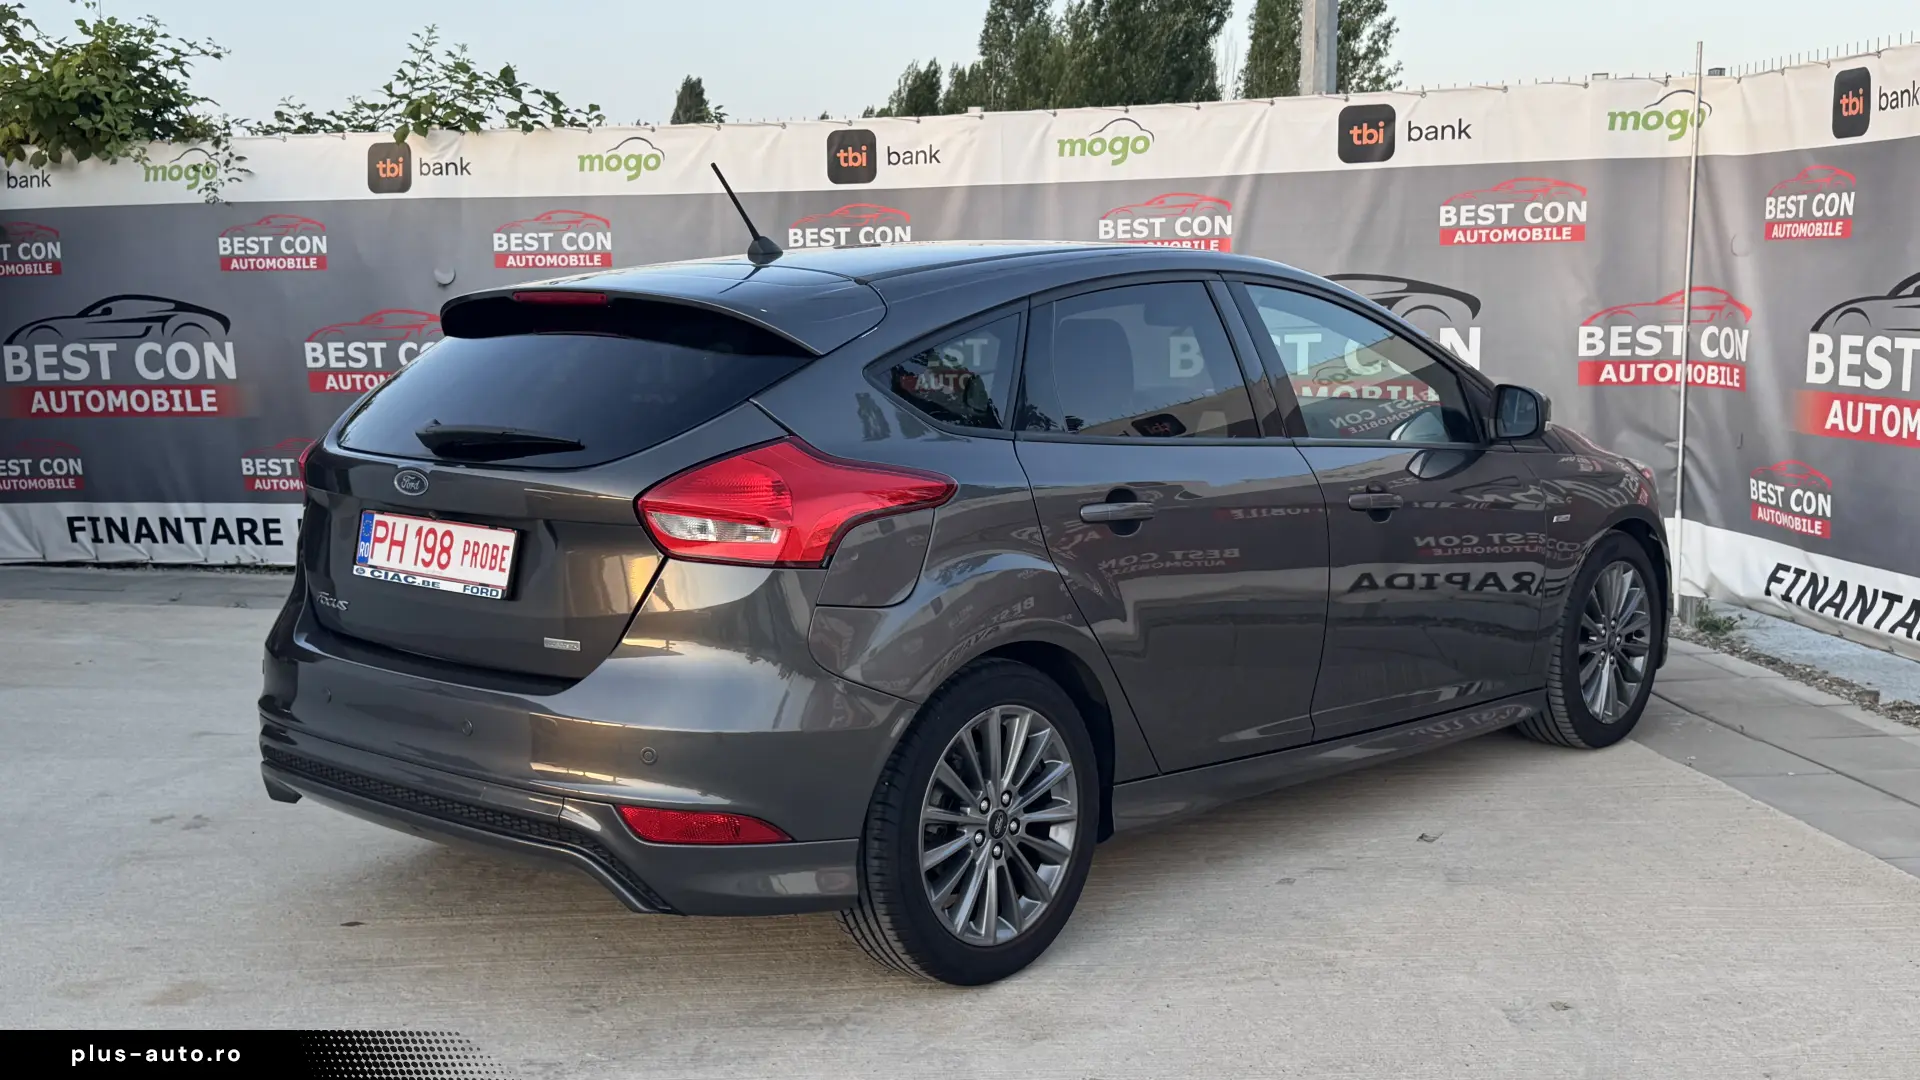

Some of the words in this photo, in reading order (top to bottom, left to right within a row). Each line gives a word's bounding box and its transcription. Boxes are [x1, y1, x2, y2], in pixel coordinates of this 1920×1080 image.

[1839, 87, 1864, 117] tbi
[1878, 80, 1920, 111] bank
[1349, 120, 1385, 146] tbi
[1407, 118, 1472, 142] bank
[1607, 107, 1706, 142] mogo
[836, 145, 867, 168] tbi
[887, 144, 941, 166] bank
[1057, 134, 1151, 166] mogo
[6, 170, 51, 189] bank
[144, 162, 218, 190] mogo
[376, 156, 404, 179] tbi
[419, 157, 471, 177] bank
[577, 151, 662, 182] mogo
[1439, 203, 1515, 227] BEST
[1524, 201, 1588, 224] CON
[1764, 195, 1807, 220] BEST
[1811, 191, 1855, 218] CON
[788, 227, 851, 248] BEST
[858, 225, 911, 244] CON
[1098, 217, 1166, 240] BEST
[1174, 215, 1232, 237] CON
[1452, 226, 1572, 244] AUTOMOBILE
[1771, 220, 1843, 239] AUTOMOBILE
[18, 241, 61, 260] CON
[218, 237, 273, 256] BEST
[280, 235, 327, 254] CON
[493, 232, 555, 252] BEST
[566, 231, 612, 251] CON
[230, 257, 317, 271] AUTOMOBILE
[506, 254, 602, 268] AUTOMOBILE
[304, 341, 387, 369] BEST
[1578, 325, 1691, 357] BEST
[1700, 325, 1749, 362] CON
[3, 343, 118, 382] BEST
[134, 341, 237, 381] CON
[1599, 362, 1740, 388] AUTOMOBILE
[1805, 332, 1920, 392] BEST
[31, 387, 218, 414] AUTOMOBILE
[40, 457, 83, 476] CON
[241, 458, 294, 476] BEST
[401, 475, 420, 490] Ford
[1750, 477, 1785, 508] BEST
[1790, 487, 1832, 518] CON
[66, 515, 284, 547] FINANTARE
[1757, 506, 1822, 535] AUTOMOBILE
[359, 541, 370, 558] RO
[370, 519, 408, 564] PH
[414, 526, 454, 571] 198
[460, 539, 510, 573] PROBE
[369, 569, 441, 589] CIAC.BE
[462, 584, 499, 598] FORD
[1764, 562, 1920, 642] FINANTA
